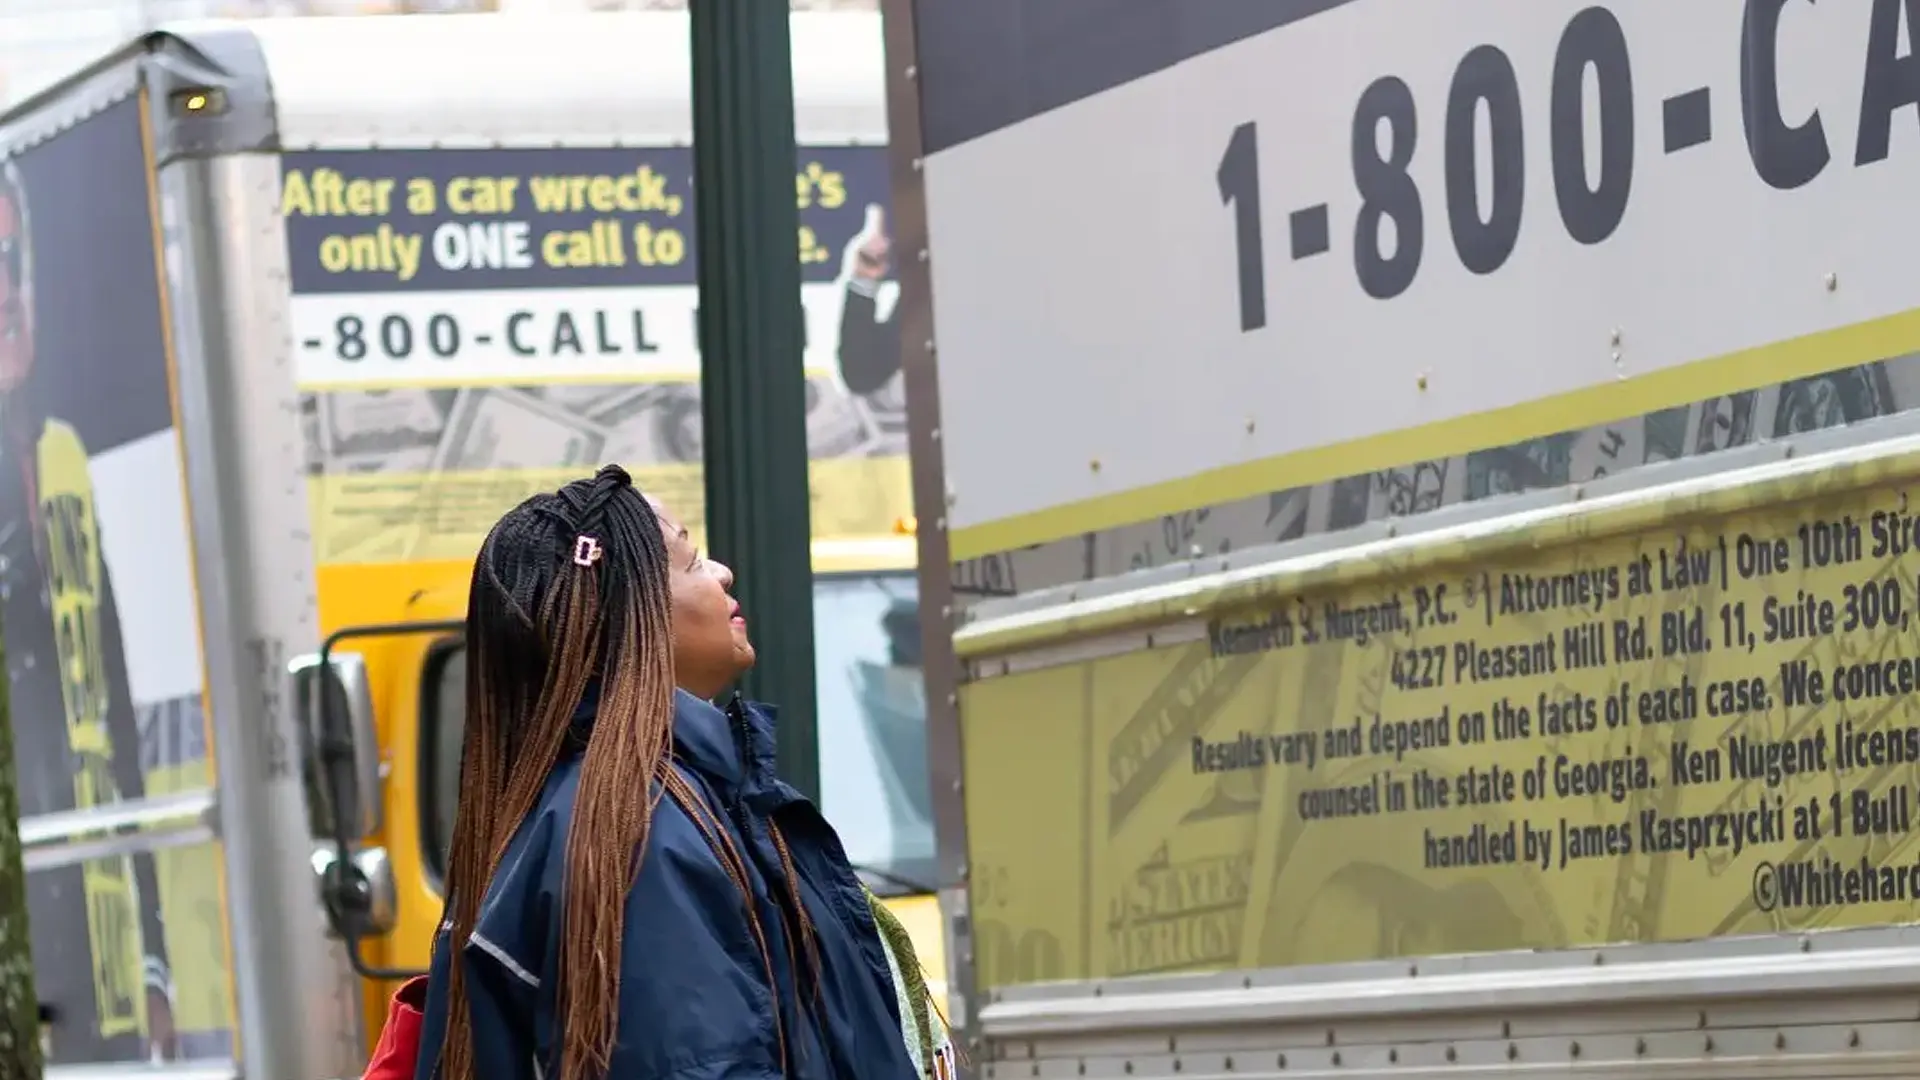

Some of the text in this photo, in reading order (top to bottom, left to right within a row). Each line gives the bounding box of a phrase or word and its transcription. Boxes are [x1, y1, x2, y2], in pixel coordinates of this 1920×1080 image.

[282, 164, 683, 216] After a car wreck,
[319, 218, 685, 280] only ONE call to
[1208, 607, 1294, 657] Kenneth
[1324, 595, 1410, 646] Nugent,
[1413, 583, 1457, 629] P.C.
[1500, 566, 1620, 615] Attorneys
[1627, 553, 1652, 597] at
[1660, 547, 1711, 590] Law
[1737, 533, 1789, 579] One
[1799, 514, 1861, 569] 10th
[1391, 645, 1446, 691] 4227
[1454, 632, 1557, 684] Pleasant
[1563, 622, 1606, 670] Hill
[1614, 615, 1653, 664] Rd.
[1662, 605, 1711, 657] Bld.
[1720, 602, 1755, 653] 11,
[1763, 589, 1834, 643] Suite
[1843, 577, 1908, 632] 300,
[1193, 730, 1265, 774] Results
[1270, 731, 1316, 770] vary
[1323, 716, 1362, 760] and
[1369, 704, 1450, 762] depend
[1457, 711, 1485, 744] on
[1492, 697, 1530, 741] the
[1538, 692, 1597, 736] facts
[1605, 681, 1630, 729] of
[1639, 674, 1698, 725] each
[1706, 676, 1772, 717] case.
[1780, 660, 1824, 706] We
[1298, 772, 1380, 820] counsel
[1385, 769, 1406, 811] in
[1412, 767, 1450, 811] the
[1455, 765, 1515, 806] state
[1522, 755, 1546, 801] of
[1554, 745, 1656, 803] Georgia.
[1671, 741, 1720, 787] Ken
[1729, 727, 1826, 788] Nugent
[1424, 785, 1909, 871] handled by James Kasprzycki at 1 Bull
